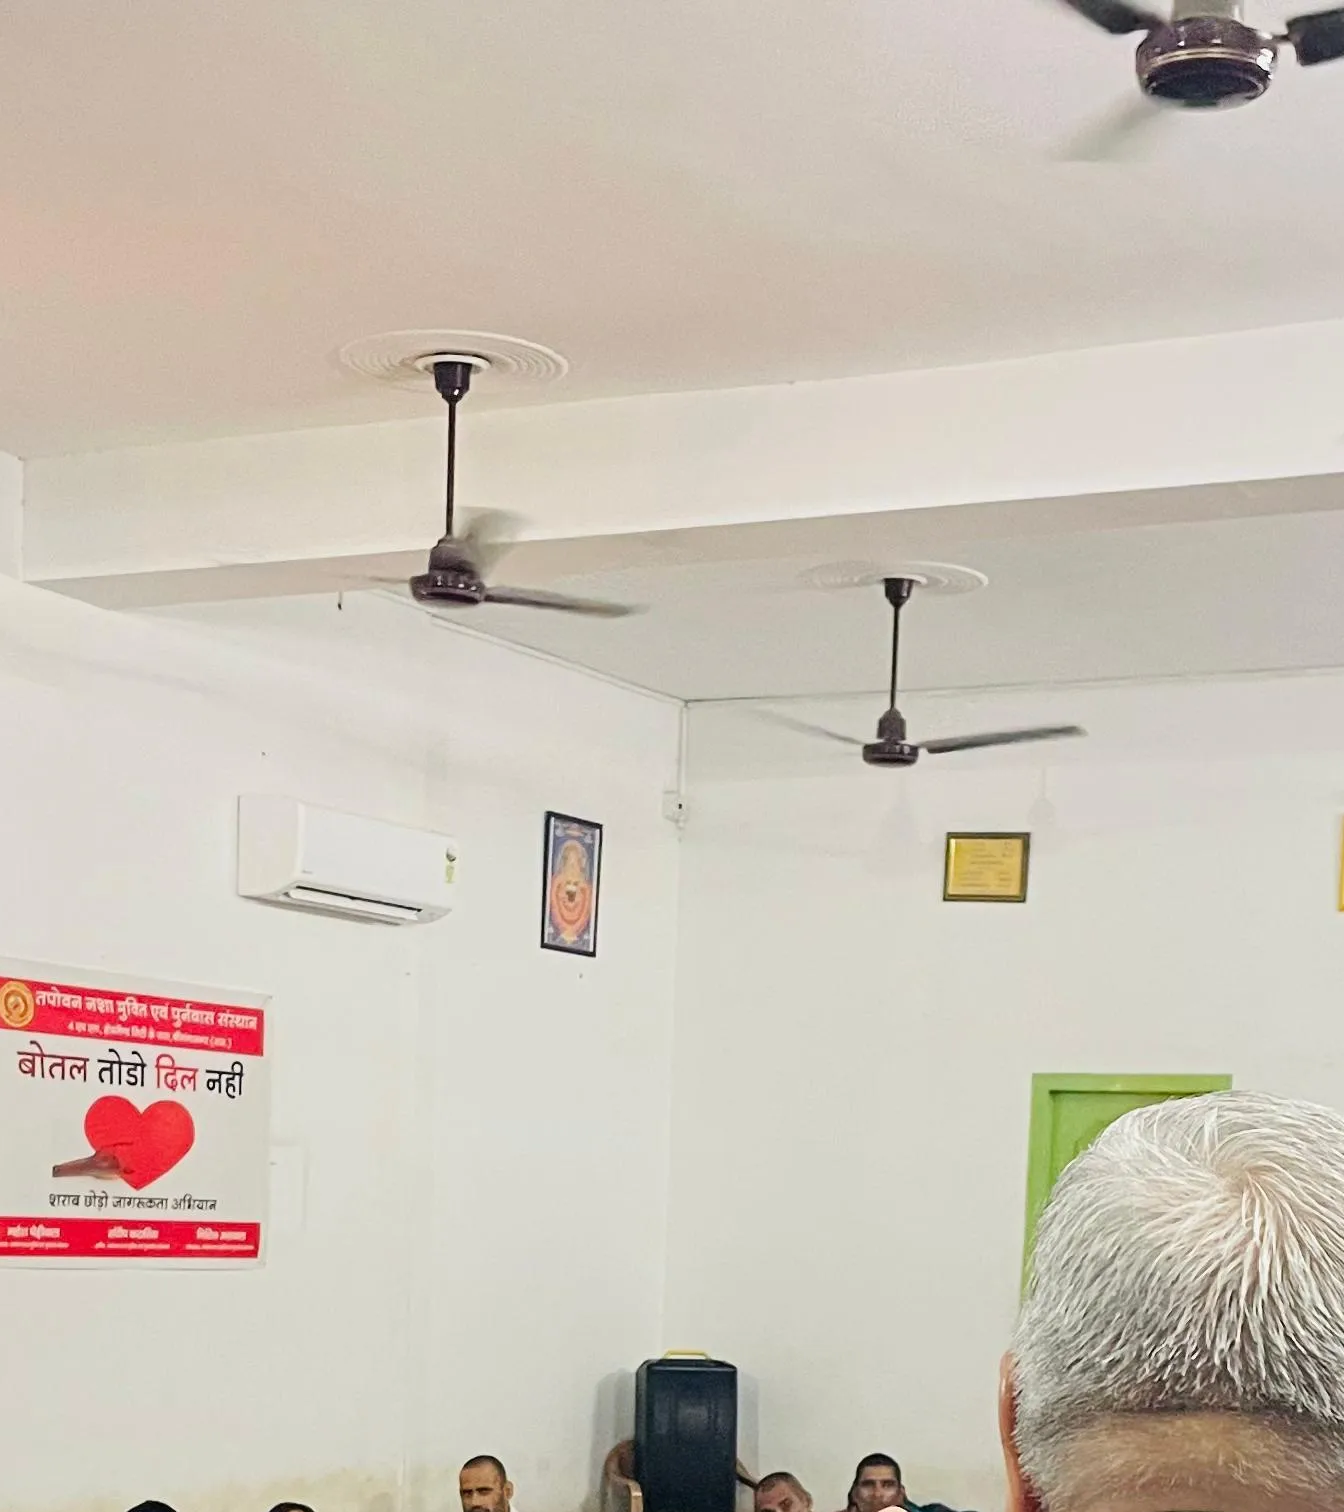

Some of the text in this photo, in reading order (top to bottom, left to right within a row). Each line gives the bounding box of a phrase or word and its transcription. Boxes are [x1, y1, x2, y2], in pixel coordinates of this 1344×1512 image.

[36, 986, 82, 1010] तपोवन
[84, 996, 114, 1014] नशा
[16, 1040, 90, 1083] बोतल
[155, 1053, 199, 1092] दिल
